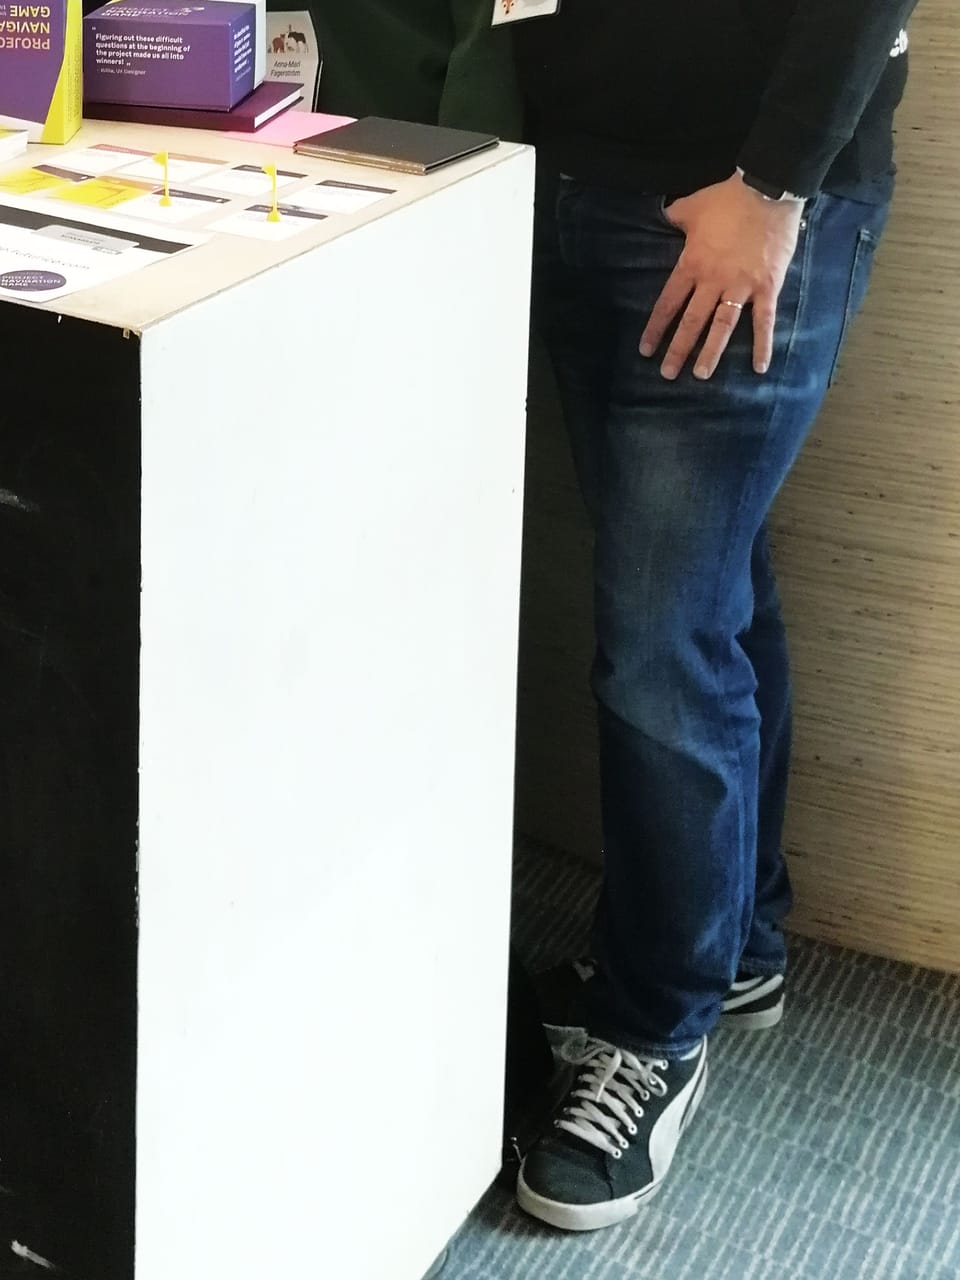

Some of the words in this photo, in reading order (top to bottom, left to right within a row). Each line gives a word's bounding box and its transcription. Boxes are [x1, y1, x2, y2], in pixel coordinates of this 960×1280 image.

[10, 5, 51, 17] GAME
[96, 33, 123, 42] Figuring
[96, 42, 128, 50] questions
[149, 44, 182, 52] beginning
